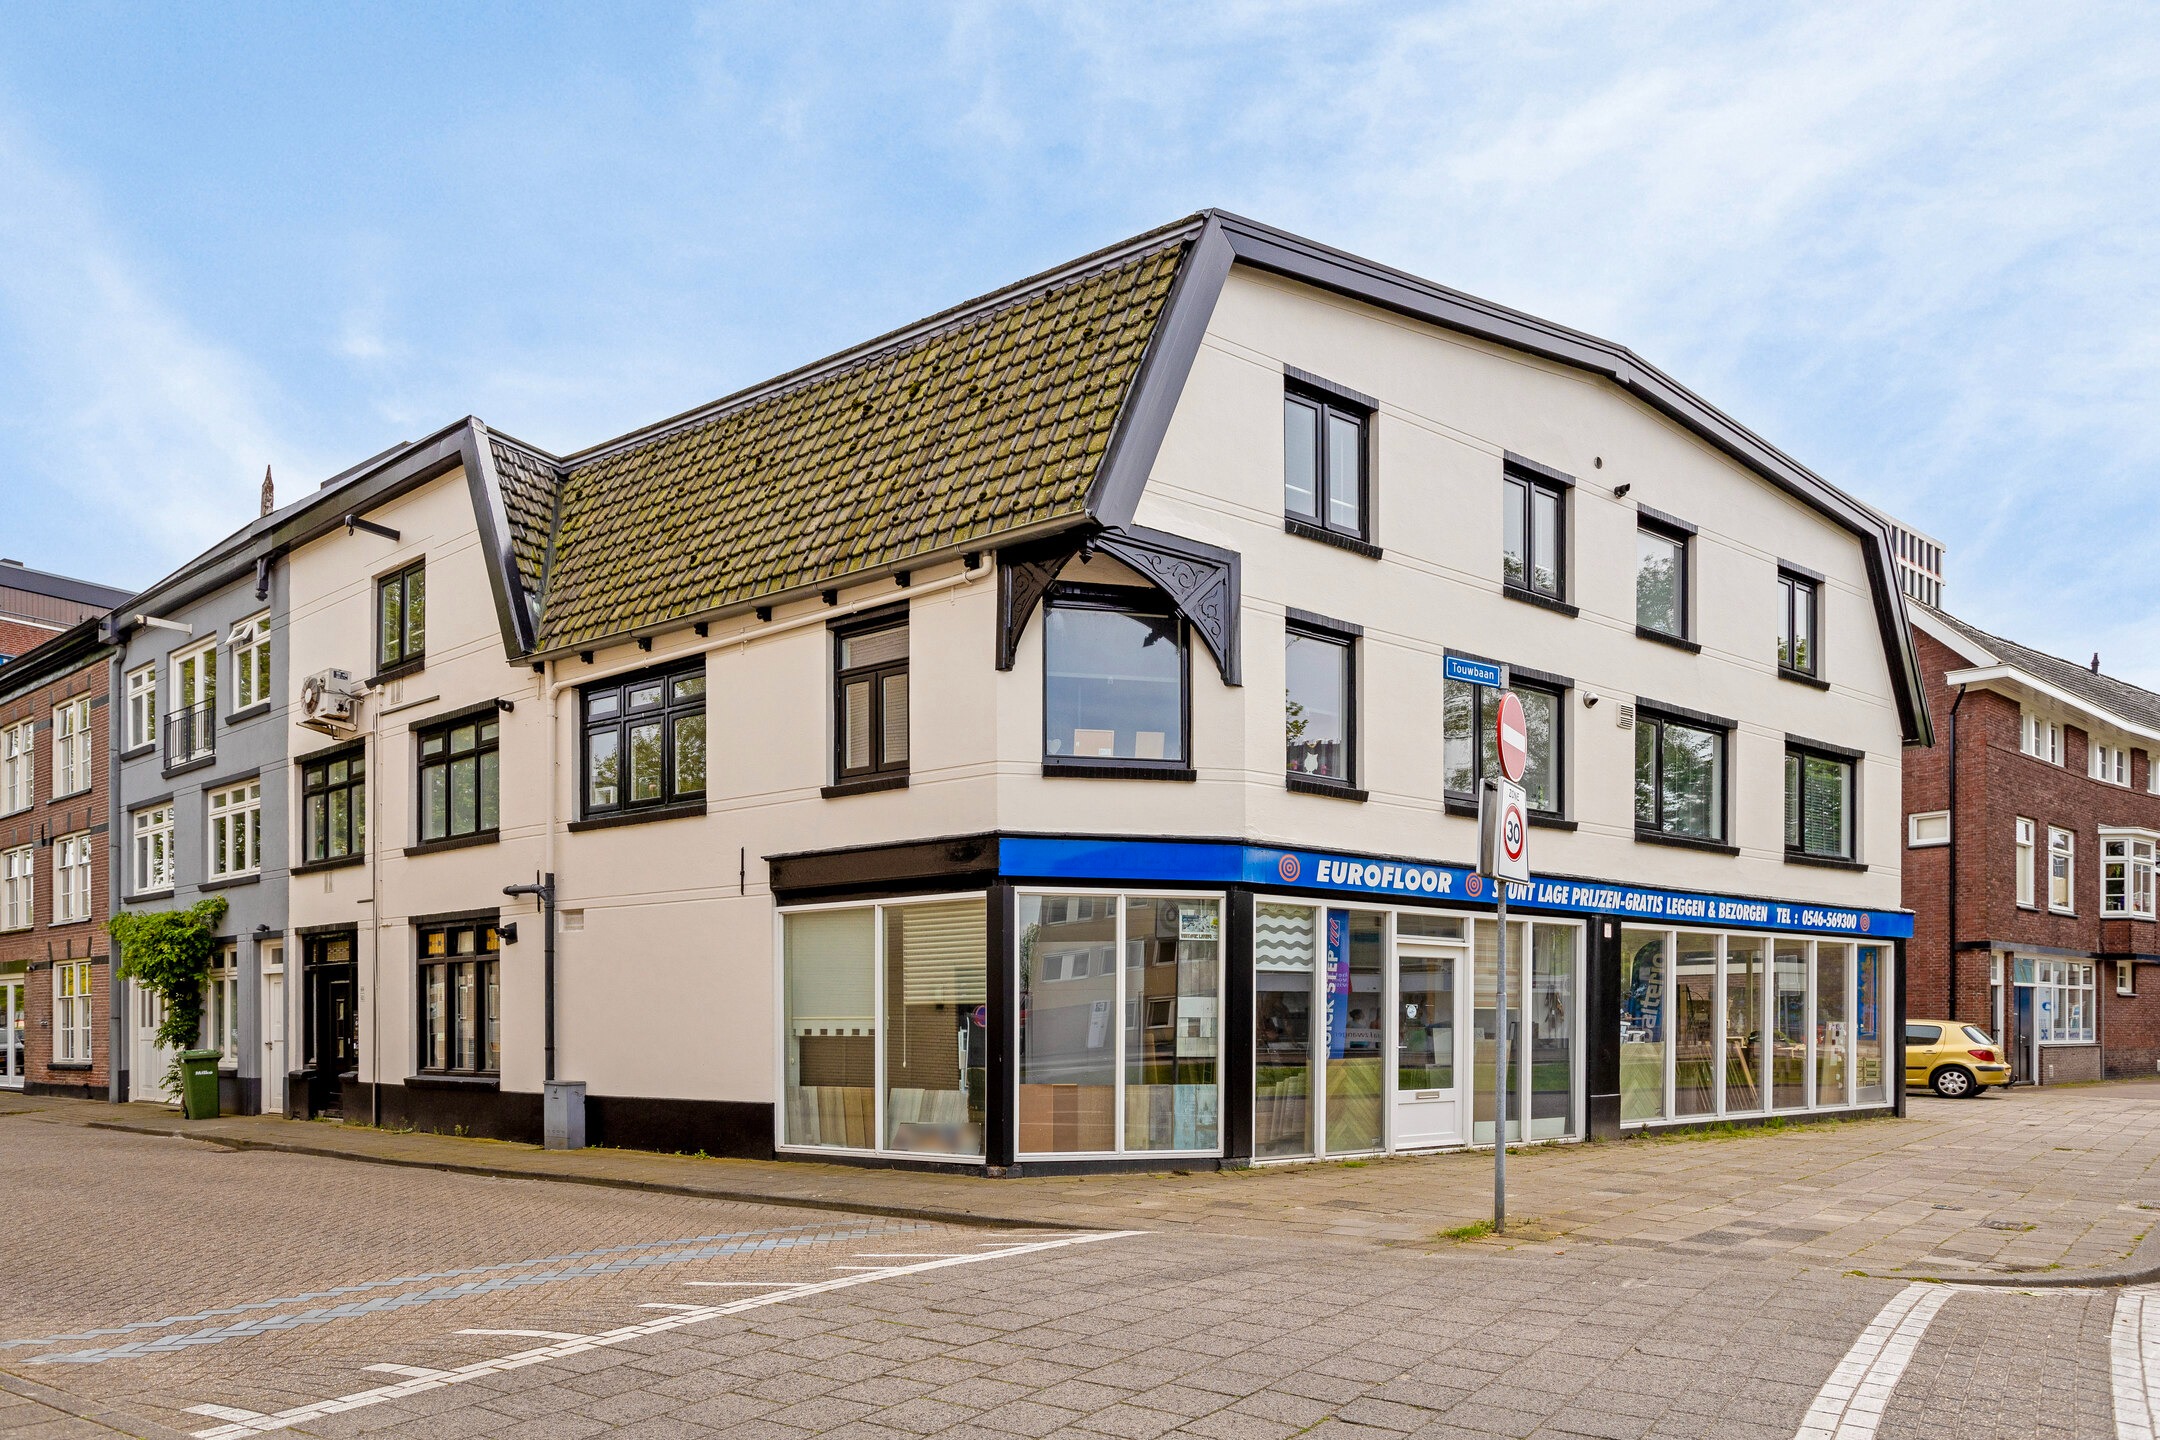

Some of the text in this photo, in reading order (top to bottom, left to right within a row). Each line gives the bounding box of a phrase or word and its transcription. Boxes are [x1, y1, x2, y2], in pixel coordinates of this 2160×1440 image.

[1452, 662, 1494, 680] Touwbaan
[1508, 788, 1520, 802] ZONE
[1507, 820, 1520, 845] 30
[1316, 859, 1452, 893] EUROFLOOR
[1537, 883, 1569, 905] LAGE
[1571, 887, 1663, 913] PRIJZEN-GRATIS
[1666, 897, 1705, 917] LEGGEN
[1708, 901, 1715, 918] &
[1718, 902, 1768, 922] BEZORGEN
[1776, 907, 1791, 924] TEL
[1802, 909, 1857, 929] 0546-569300
